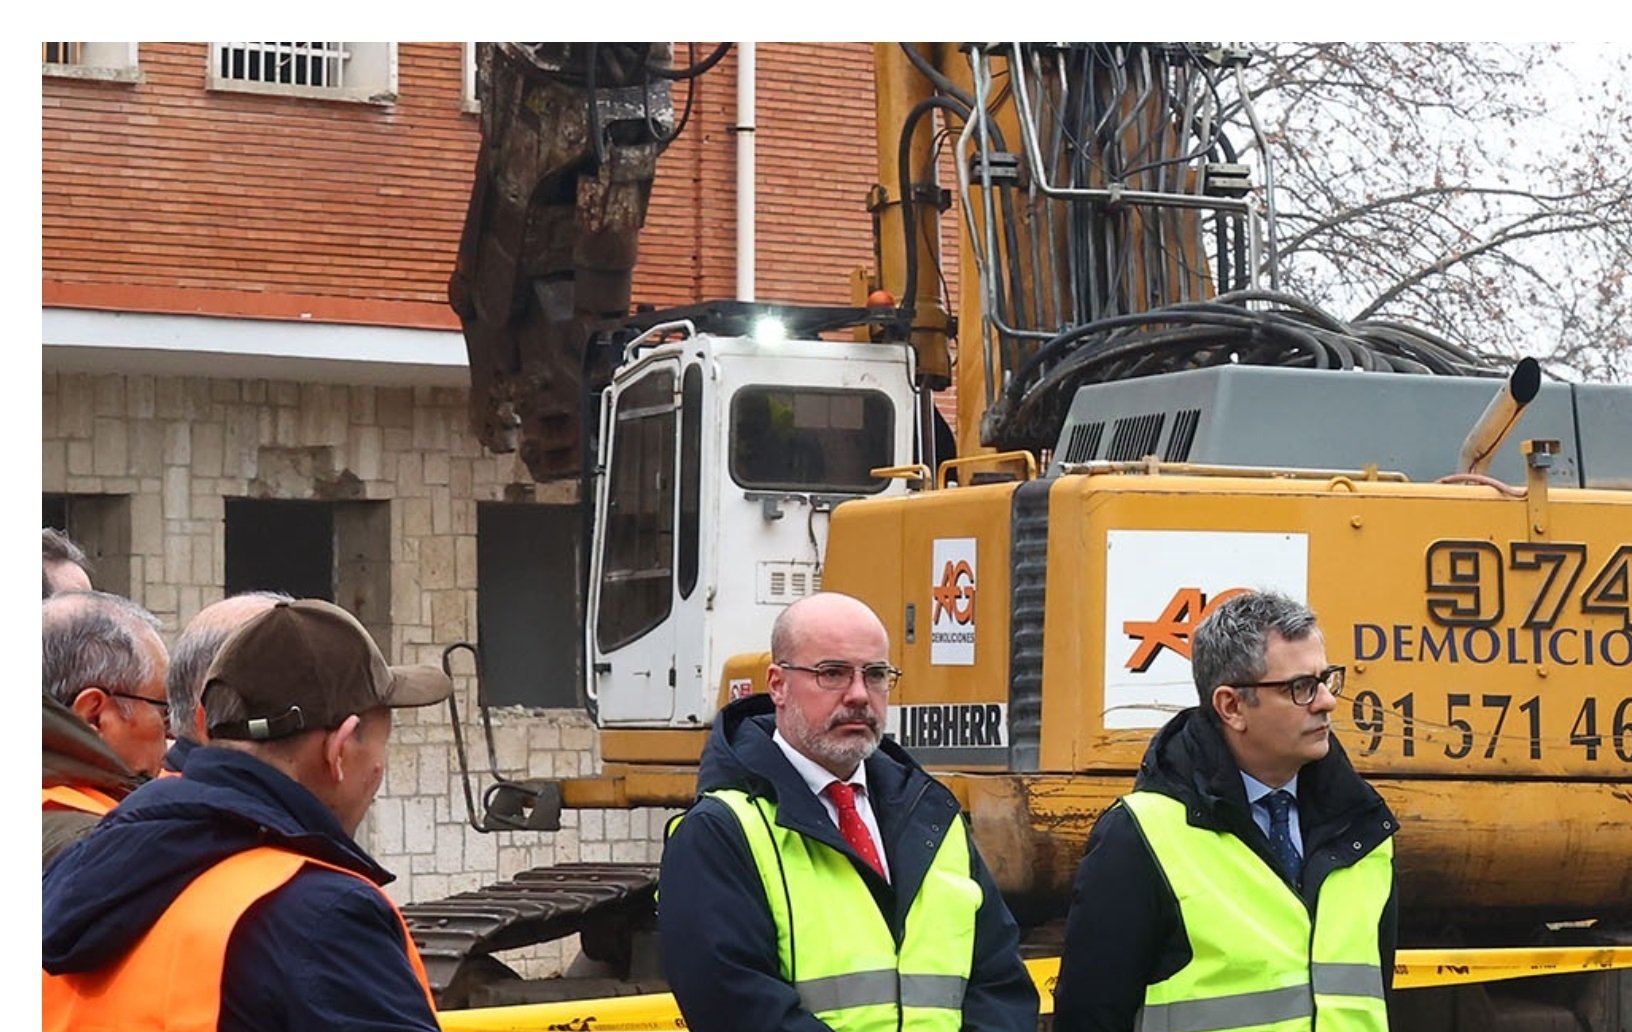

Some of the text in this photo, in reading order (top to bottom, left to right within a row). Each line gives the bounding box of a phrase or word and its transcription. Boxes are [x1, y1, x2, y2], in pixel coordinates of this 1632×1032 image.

[933, 560, 975, 625] AG
[901, 705, 1001, 747] LIEBHERR
[1352, 690, 1414, 758] 91
[1444, 693, 1542, 760] 571
